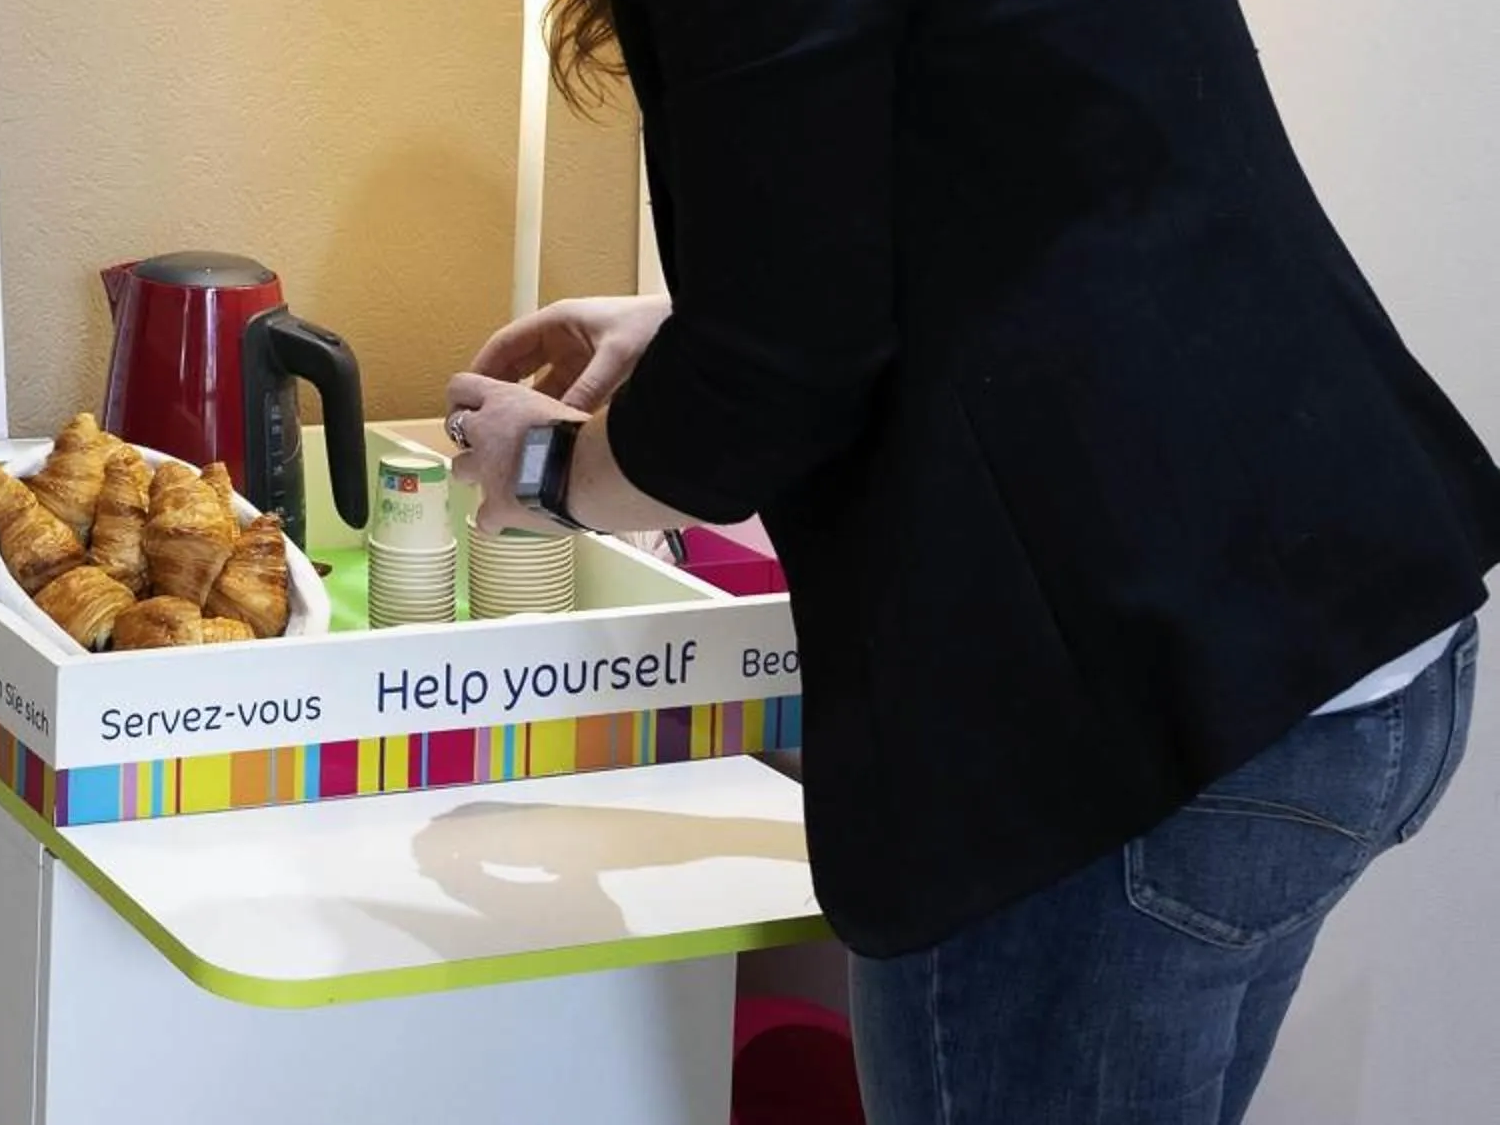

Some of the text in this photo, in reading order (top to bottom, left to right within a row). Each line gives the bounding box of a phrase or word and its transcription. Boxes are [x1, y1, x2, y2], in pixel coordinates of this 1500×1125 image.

[4, 682, 24, 715] Sie
[25, 700, 50, 737] sich
[100, 694, 323, 742] Servez-vous
[376, 667, 487, 715] Help
[502, 639, 698, 711] yourself
